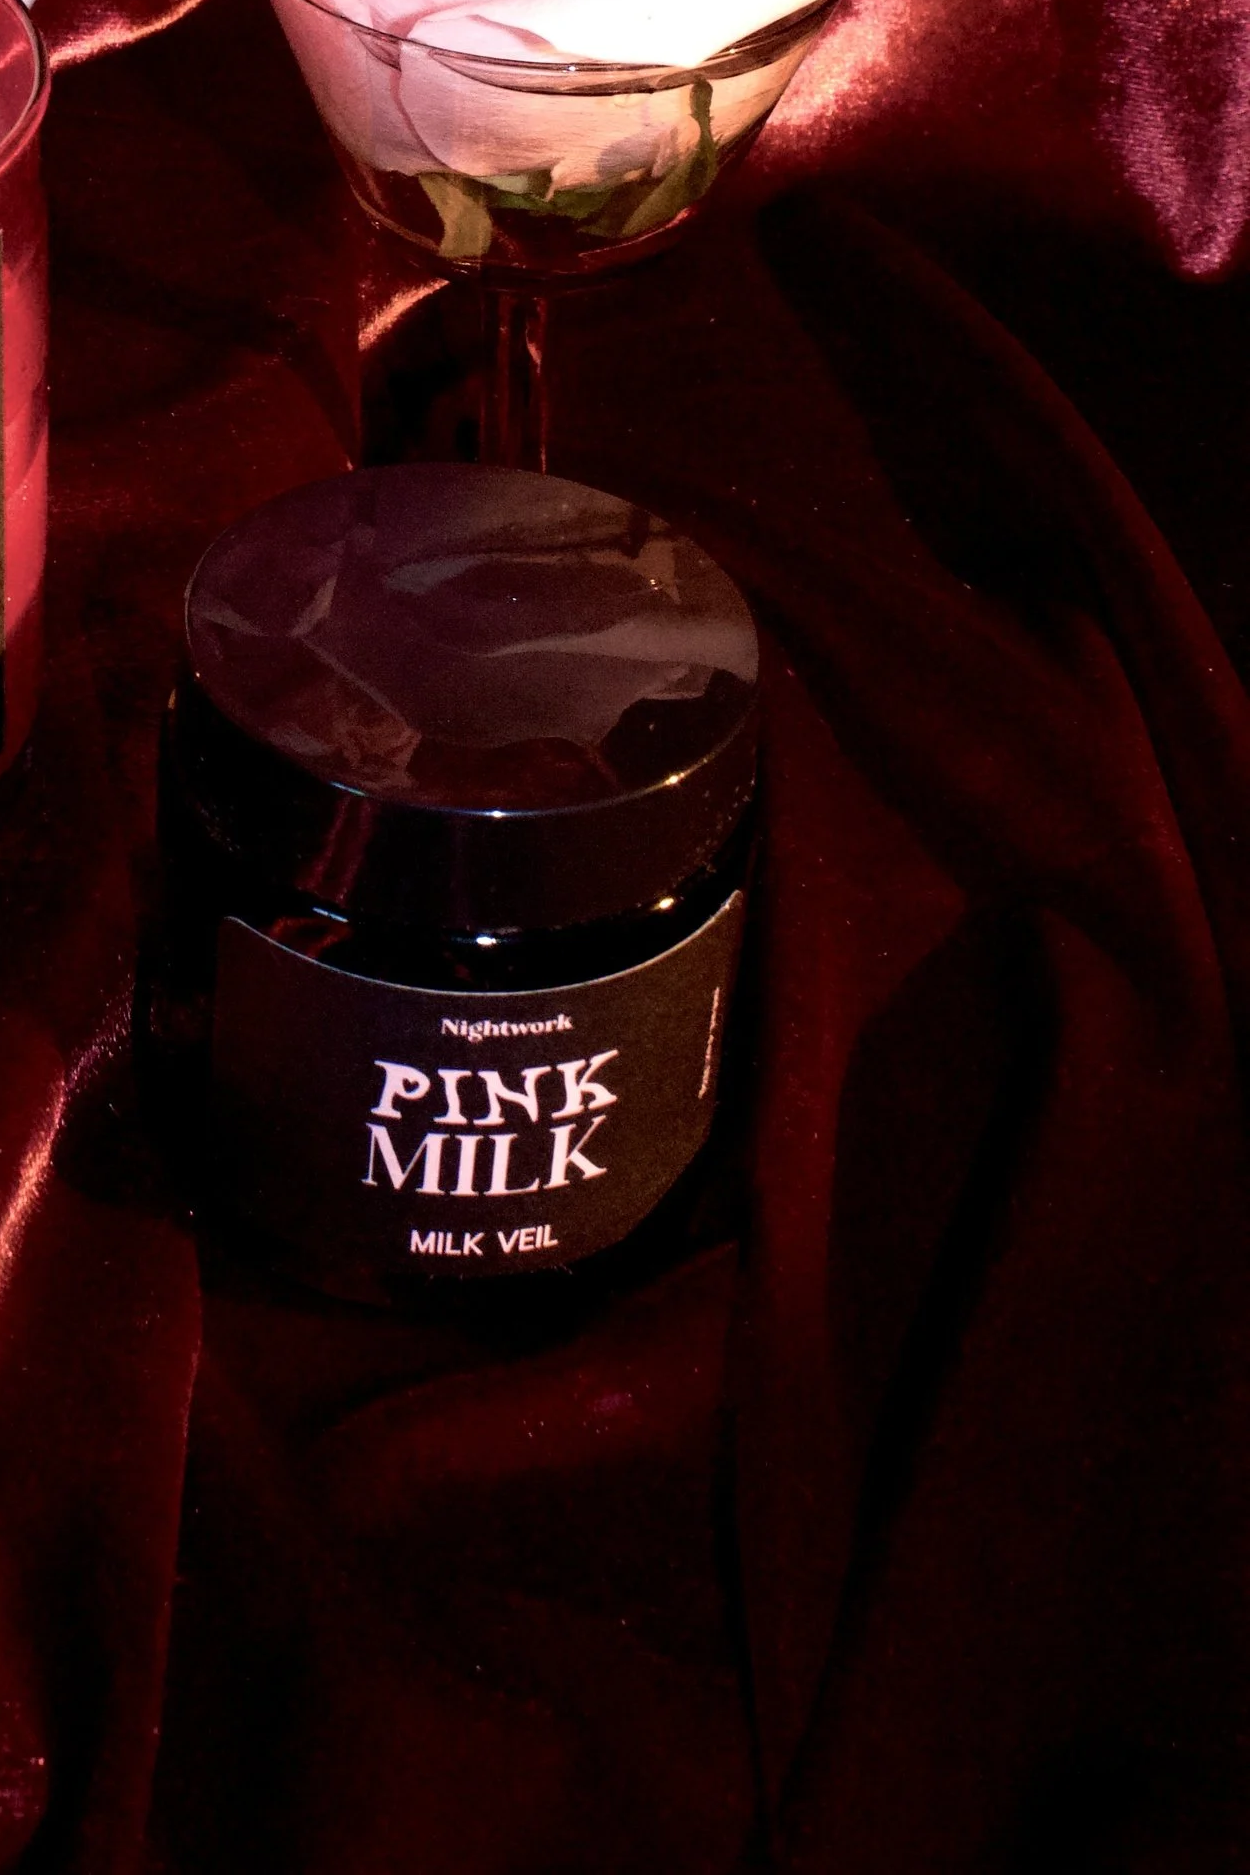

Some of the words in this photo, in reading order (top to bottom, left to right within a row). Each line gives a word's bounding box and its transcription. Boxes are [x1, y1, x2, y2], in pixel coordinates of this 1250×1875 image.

[441, 1013, 573, 1042] Nightwork
[370, 1050, 619, 1126] PINK
[362, 1114, 607, 1196] MILK
[410, 1229, 484, 1256] MILK
[497, 1224, 559, 1254] VEIL
